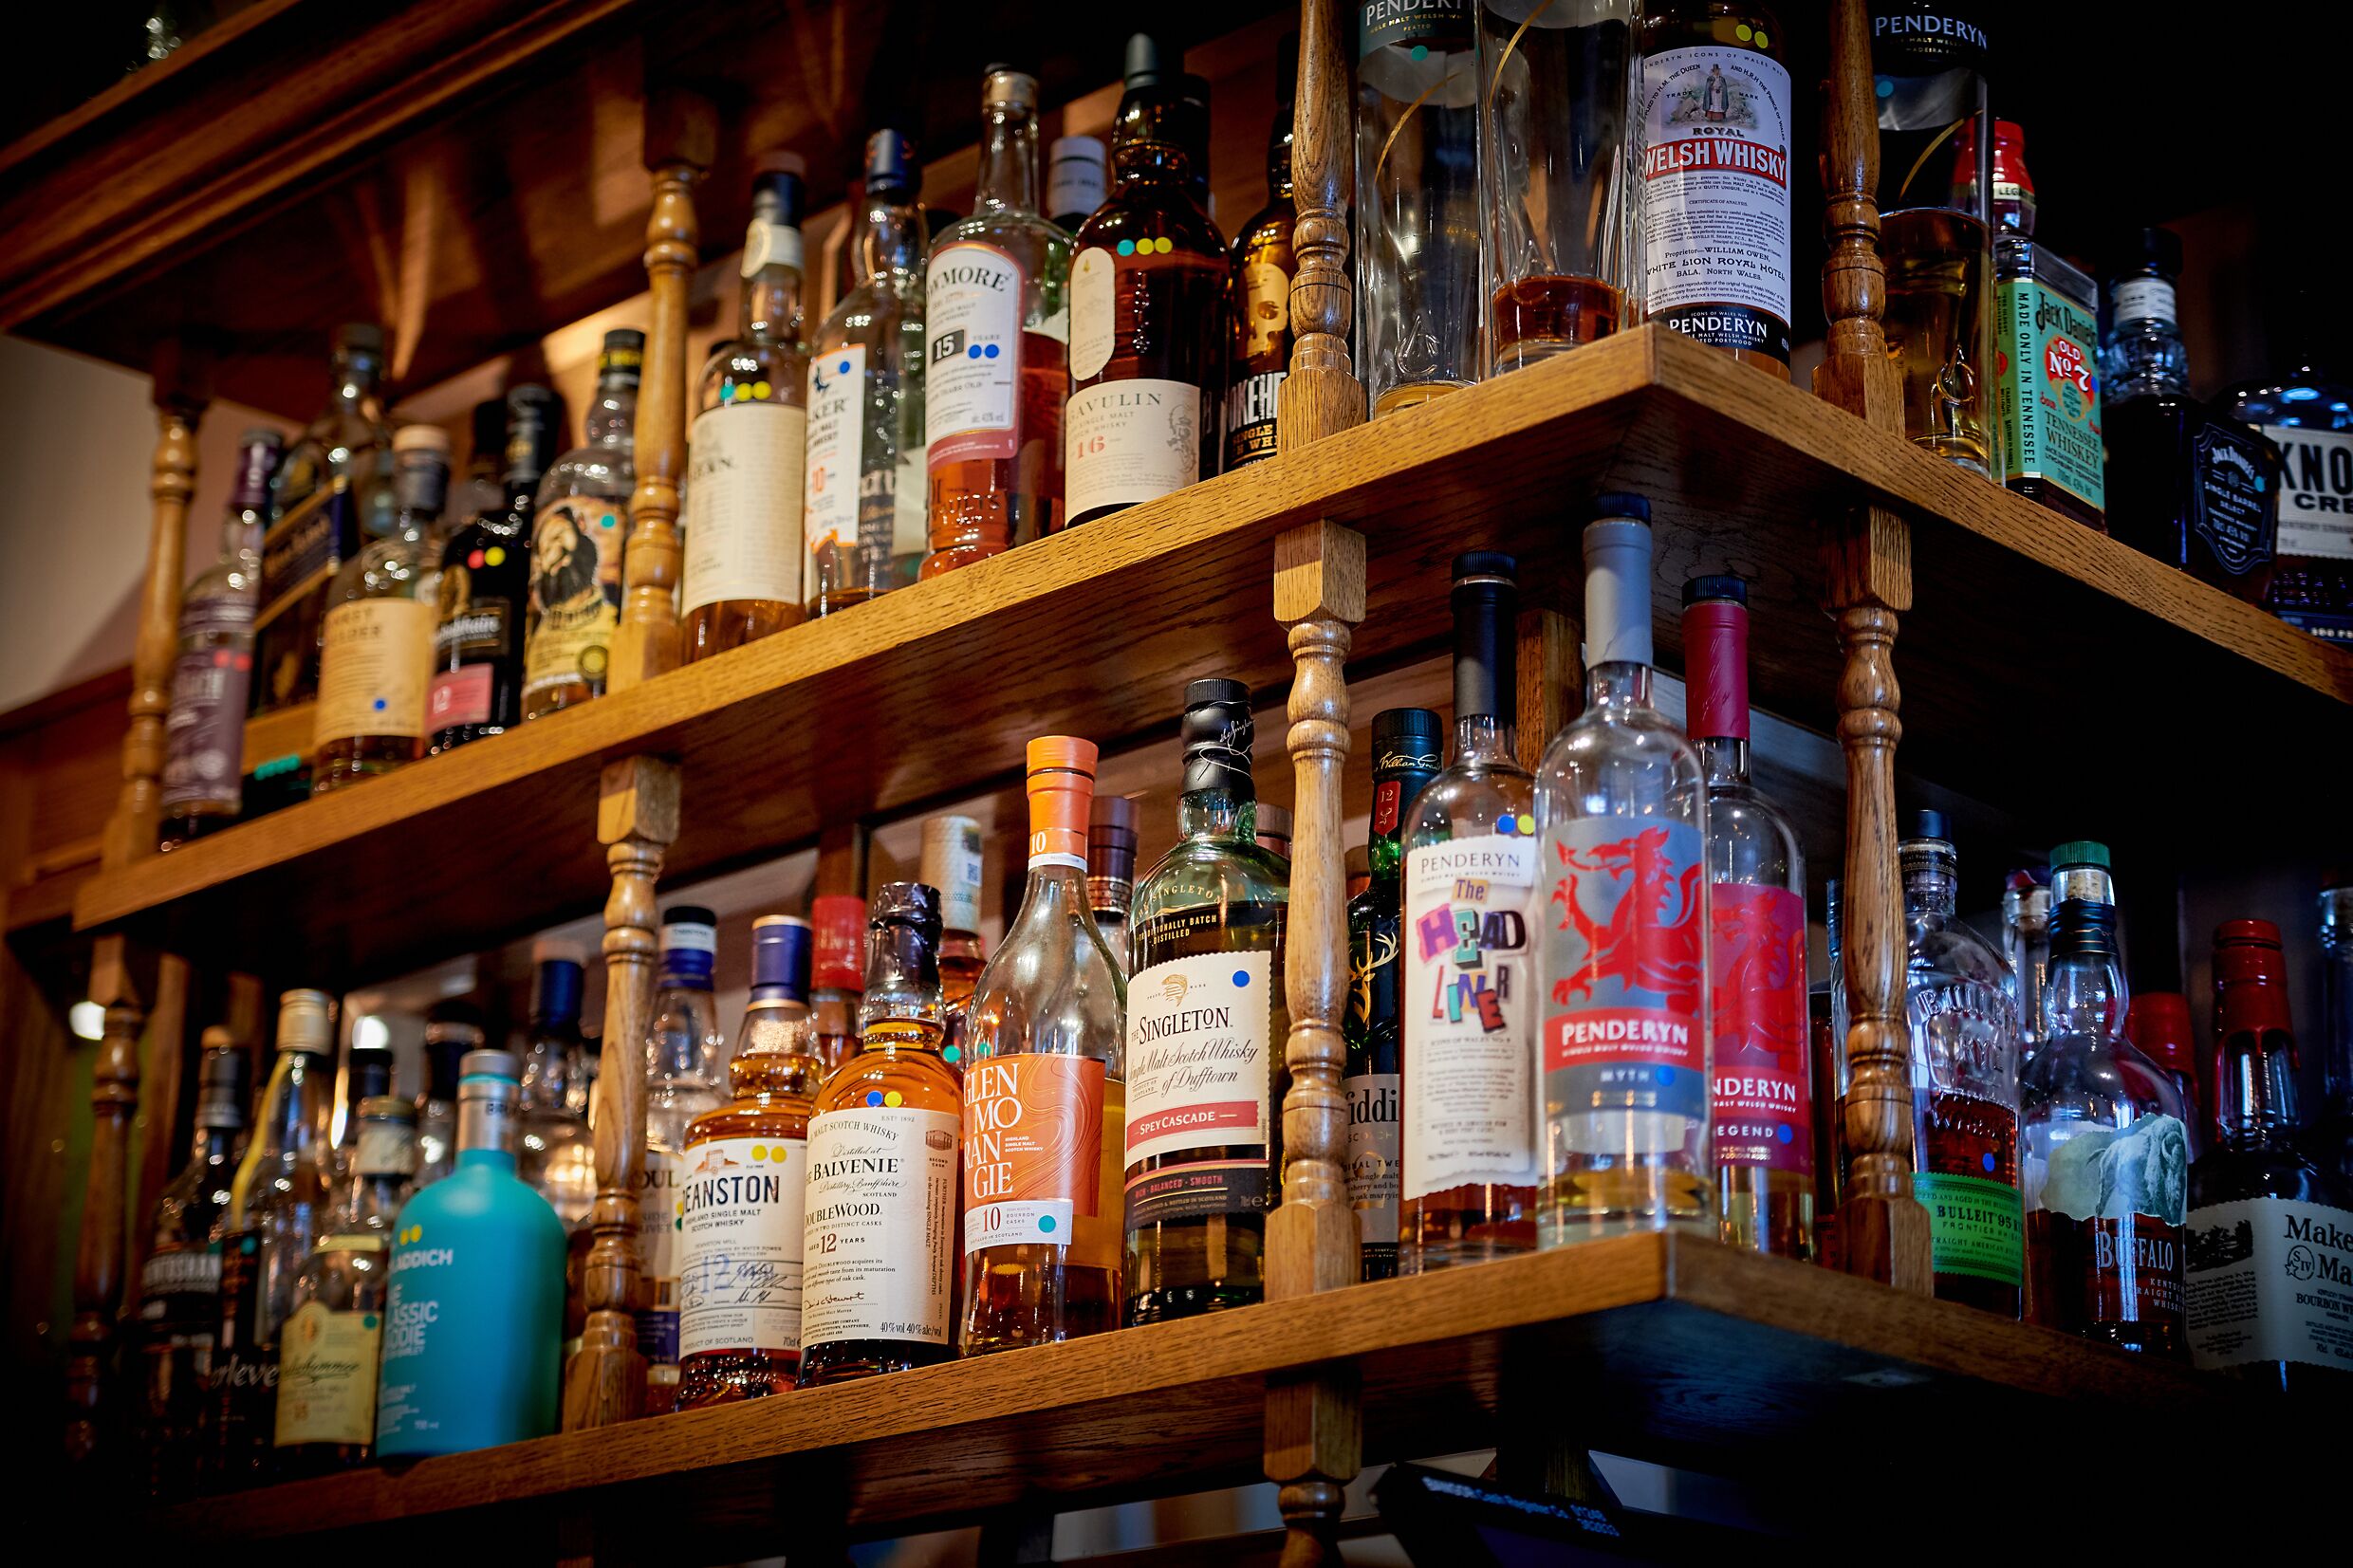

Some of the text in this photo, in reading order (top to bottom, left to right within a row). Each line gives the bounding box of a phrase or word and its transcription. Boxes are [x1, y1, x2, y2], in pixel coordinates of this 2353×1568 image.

[1388, 15, 1410, 27] MALT
[1875, 14, 1988, 51] PENDERYN
[1669, 71, 1680, 82] THE
[1679, 64, 1701, 75] QUEEN
[1730, 65, 1743, 73] AND
[1665, 90, 1694, 100] TRADE
[1738, 91, 1759, 101] MARK
[1692, 126, 1746, 138] ROYAL
[1645, 139, 1787, 182] WELSH WHISKY
[1677, 268, 1701, 278] BALA,
[1682, 257, 1712, 267] LION
[1717, 257, 1756, 269] ROYAL
[2036, 291, 2063, 334] Jack
[1670, 317, 1768, 339] PENDERYN
[1742, 334, 1765, 344] WHISKY
[935, 336, 956, 361] 15
[1714, 338, 1752, 346] PORTWOOD
[2058, 340, 2082, 360] OLD
[2017, 291, 2035, 464] MADE ONLY IN TENNESSEE
[2073, 364, 2092, 392] 7
[1109, 410, 1136, 422] MALT
[1095, 421, 1128, 436] WHISKY
[2044, 410, 2100, 452] TENNESSEE
[1076, 434, 1106, 462] 16
[2046, 427, 2100, 470] WHISKEY
[2278, 441, 2353, 496] KNO
[2294, 493, 2353, 513] CRE
[1380, 789, 1395, 803] 12
[1031, 831, 1047, 855] 10
[1421, 853, 1521, 875] PENDERYN
[1152, 884, 1225, 905] SINGLETON
[1456, 878, 1486, 901] The
[1189, 914, 1218, 926] BATCH
[1152, 928, 1191, 946] DISTILLED
[1420, 906, 1528, 969] HEAD
[1431, 963, 1510, 1034] LINER
[1130, 1007, 1231, 1045] THE SINGLETON
[1561, 1018, 1689, 1046] PENDERYN
[1168, 1042, 1210, 1068] Scotch
[1207, 1036, 1259, 1065] Whisky
[963, 1062, 1020, 1108] GLEN
[1160, 1070, 1177, 1098] of
[1601, 1069, 1650, 1082] MYTH
[1712, 1078, 1797, 1103] NDERYN
[973, 1096, 1023, 1134] MO
[1737, 1100, 1797, 1114] WELSH WHISKY
[813, 1120, 900, 1142] MALT SCOTCH WHISKY
[1717, 1124, 1774, 1138] EGEND
[964, 1131, 1003, 1172] RAN
[813, 1158, 899, 1182] BALVENIE
[973, 1162, 1013, 1200] GIE
[683, 1174, 780, 1215] EANSTON
[1150, 1174, 1224, 1193] BALANCED SMOOTH
[711, 1208, 761, 1219] SINGLE MALT
[714, 1219, 745, 1228] WHISKY
[983, 1207, 1001, 1232] 10
[1936, 1206, 1993, 1225] BULLEIT
[831, 1220, 861, 1230] DISTINCT
[1942, 1222, 1995, 1235] FRONTIER
[2284, 1214, 2353, 1254] Make
[808, 1232, 866, 1255] AGED 12 YEARS
[2098, 1230, 2174, 1272] BUFFALO
[2300, 1261, 2312, 1273] IV
[2296, 1292, 2341, 1312] BOURBON
[715, 1336, 754, 1345] SCOTLAND
